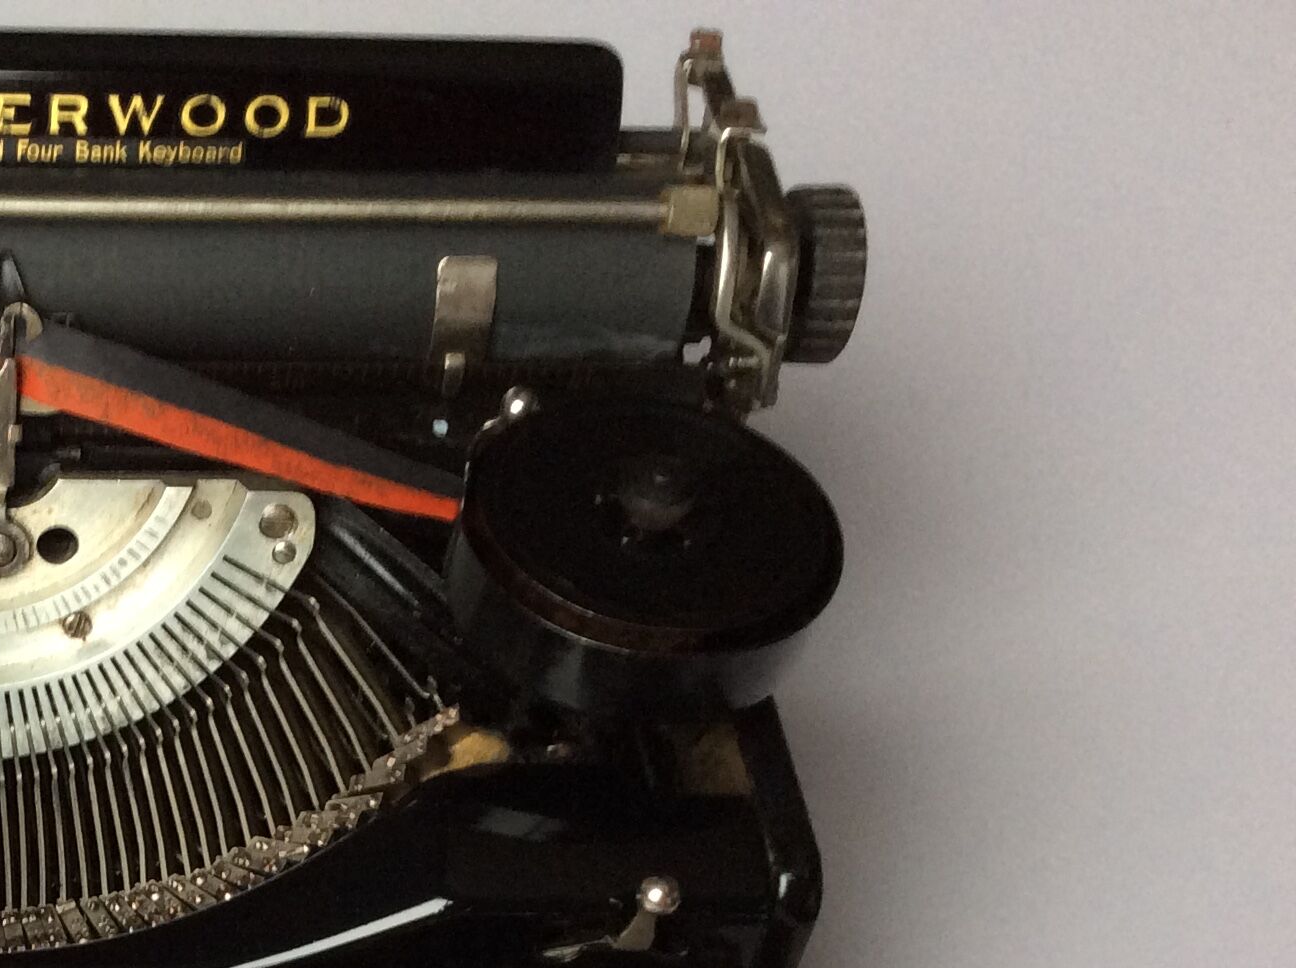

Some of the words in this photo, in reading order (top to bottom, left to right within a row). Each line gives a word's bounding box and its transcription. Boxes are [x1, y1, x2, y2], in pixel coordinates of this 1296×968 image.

[17, 138, 63, 162] Four
[75, 140, 127, 163] Bank
[139, 140, 243, 165] Keyboard
